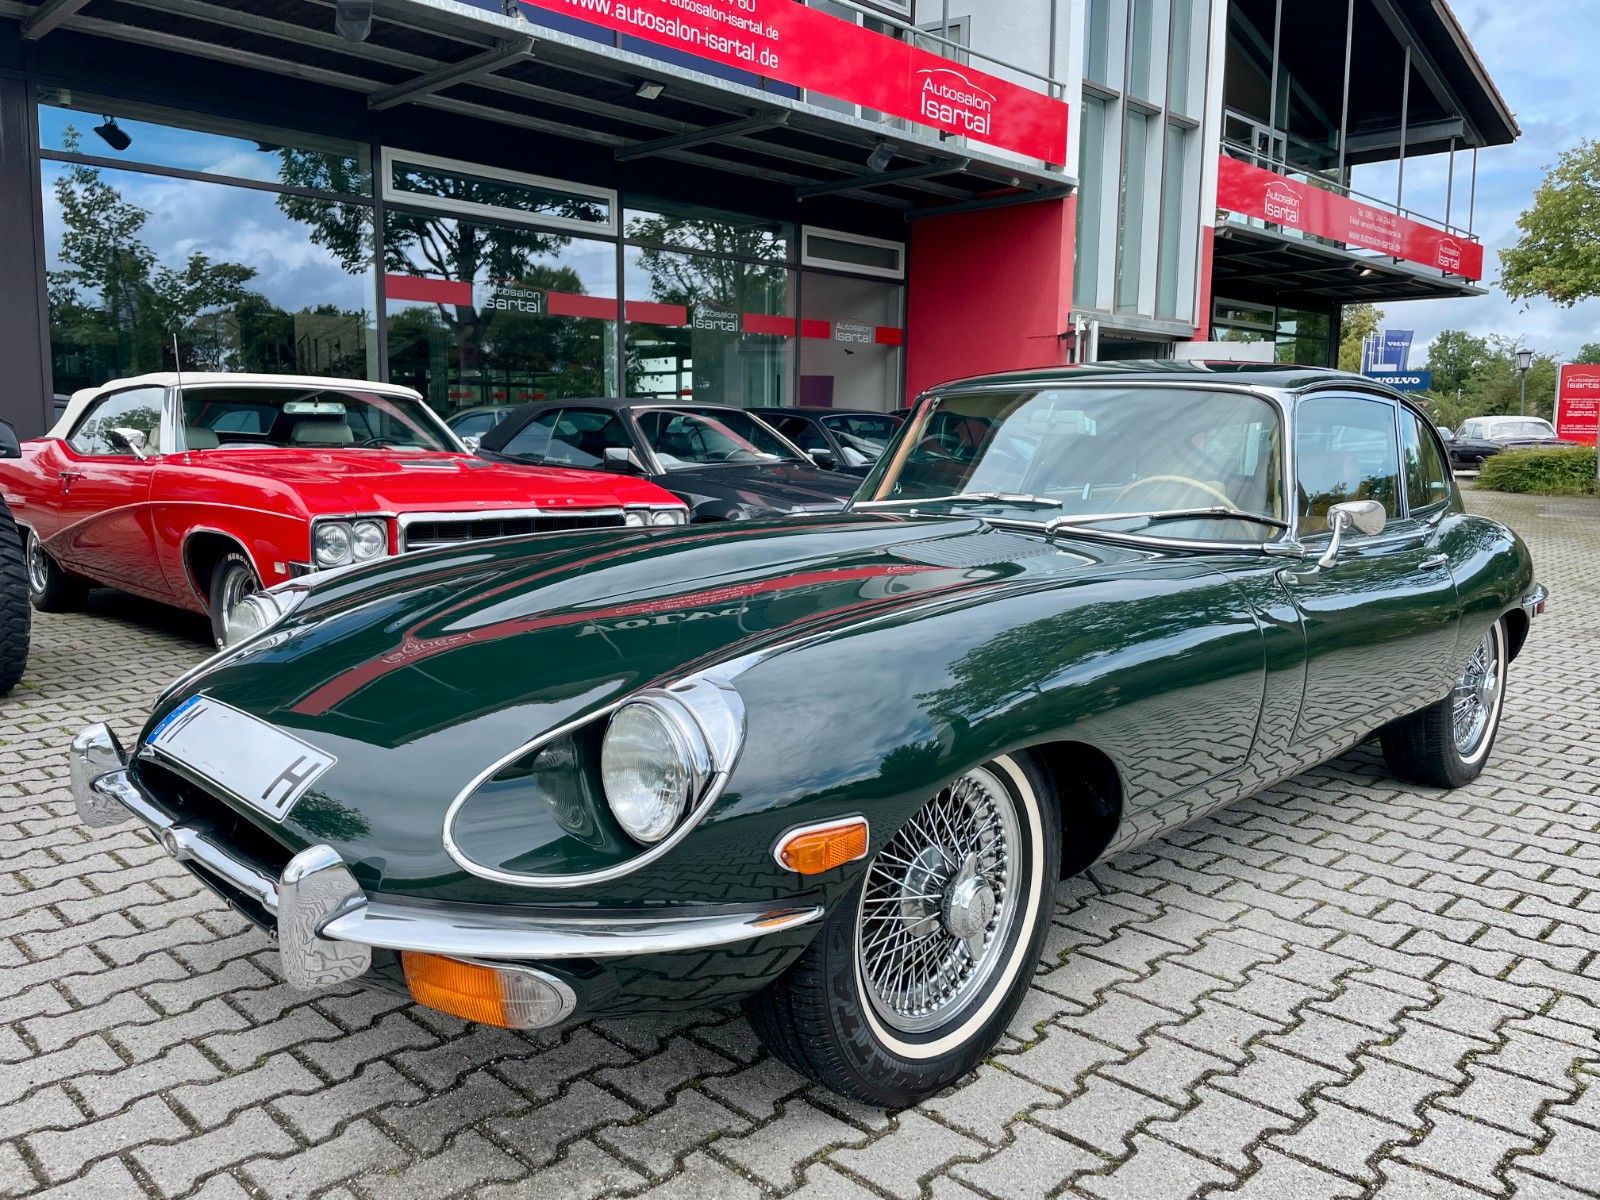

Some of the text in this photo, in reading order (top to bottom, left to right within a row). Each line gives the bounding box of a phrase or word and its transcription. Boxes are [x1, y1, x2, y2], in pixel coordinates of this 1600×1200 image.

[922, 77, 991, 112] Autosalon
[920, 91, 991, 136] Isartal
[1265, 187, 1300, 208] Autosalon
[1264, 198, 1299, 224] Isartal
[1438, 251, 1461, 270] Isartal
[484, 297, 541, 314] sartal
[692, 315, 738, 332] Isartal
[836, 322, 872, 333] Autosalon
[835, 329, 872, 344] Isartal
[1374, 376, 1421, 384] VOLVO
[261, 754, 323, 809] H
